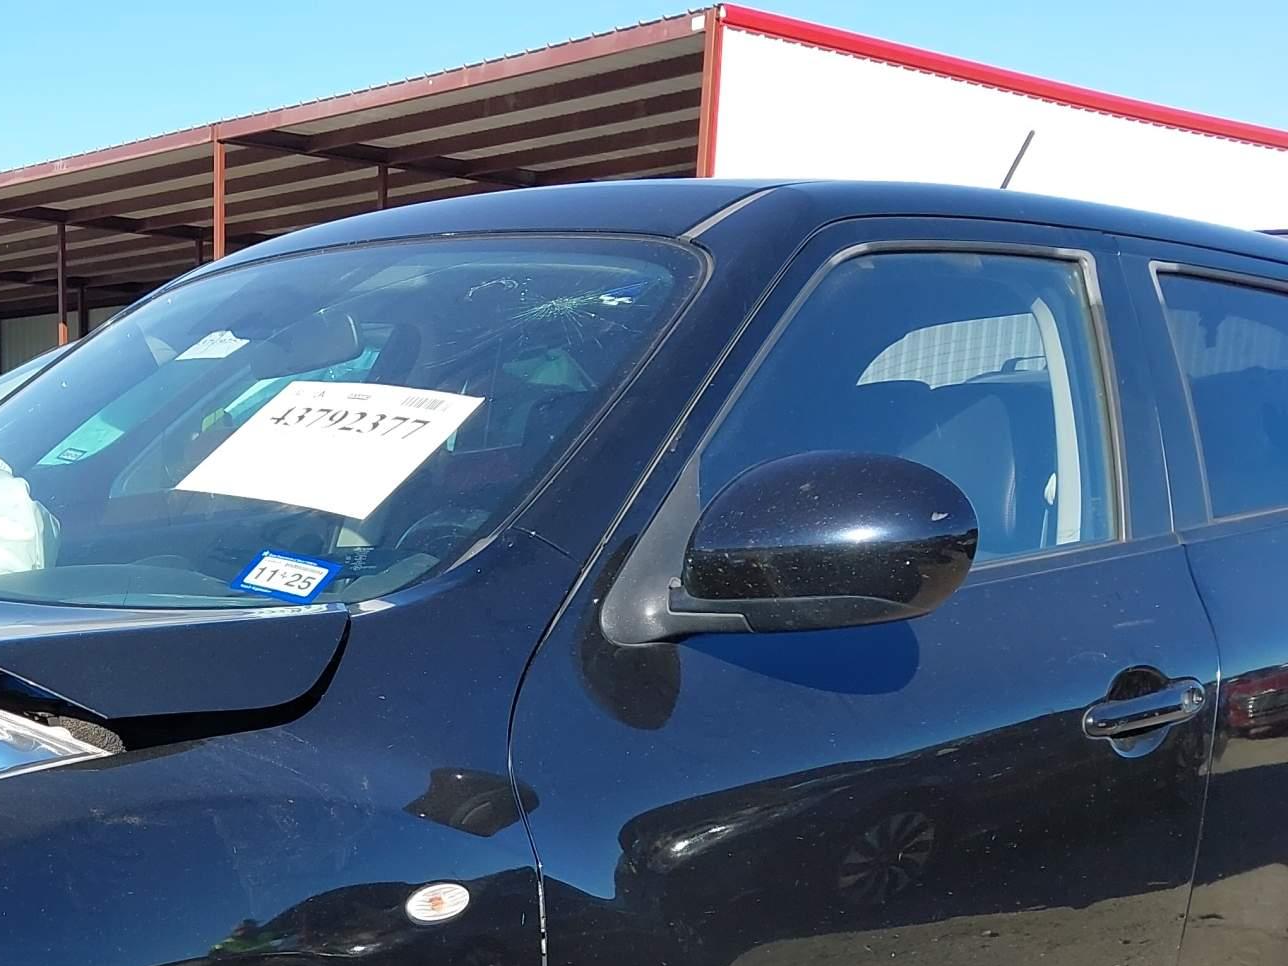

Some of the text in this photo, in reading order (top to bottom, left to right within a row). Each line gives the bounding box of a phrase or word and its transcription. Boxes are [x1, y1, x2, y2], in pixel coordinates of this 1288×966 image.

[270, 406, 432, 440] 43792377
[253, 566, 280, 583] 11
[284, 572, 317, 590] 25
